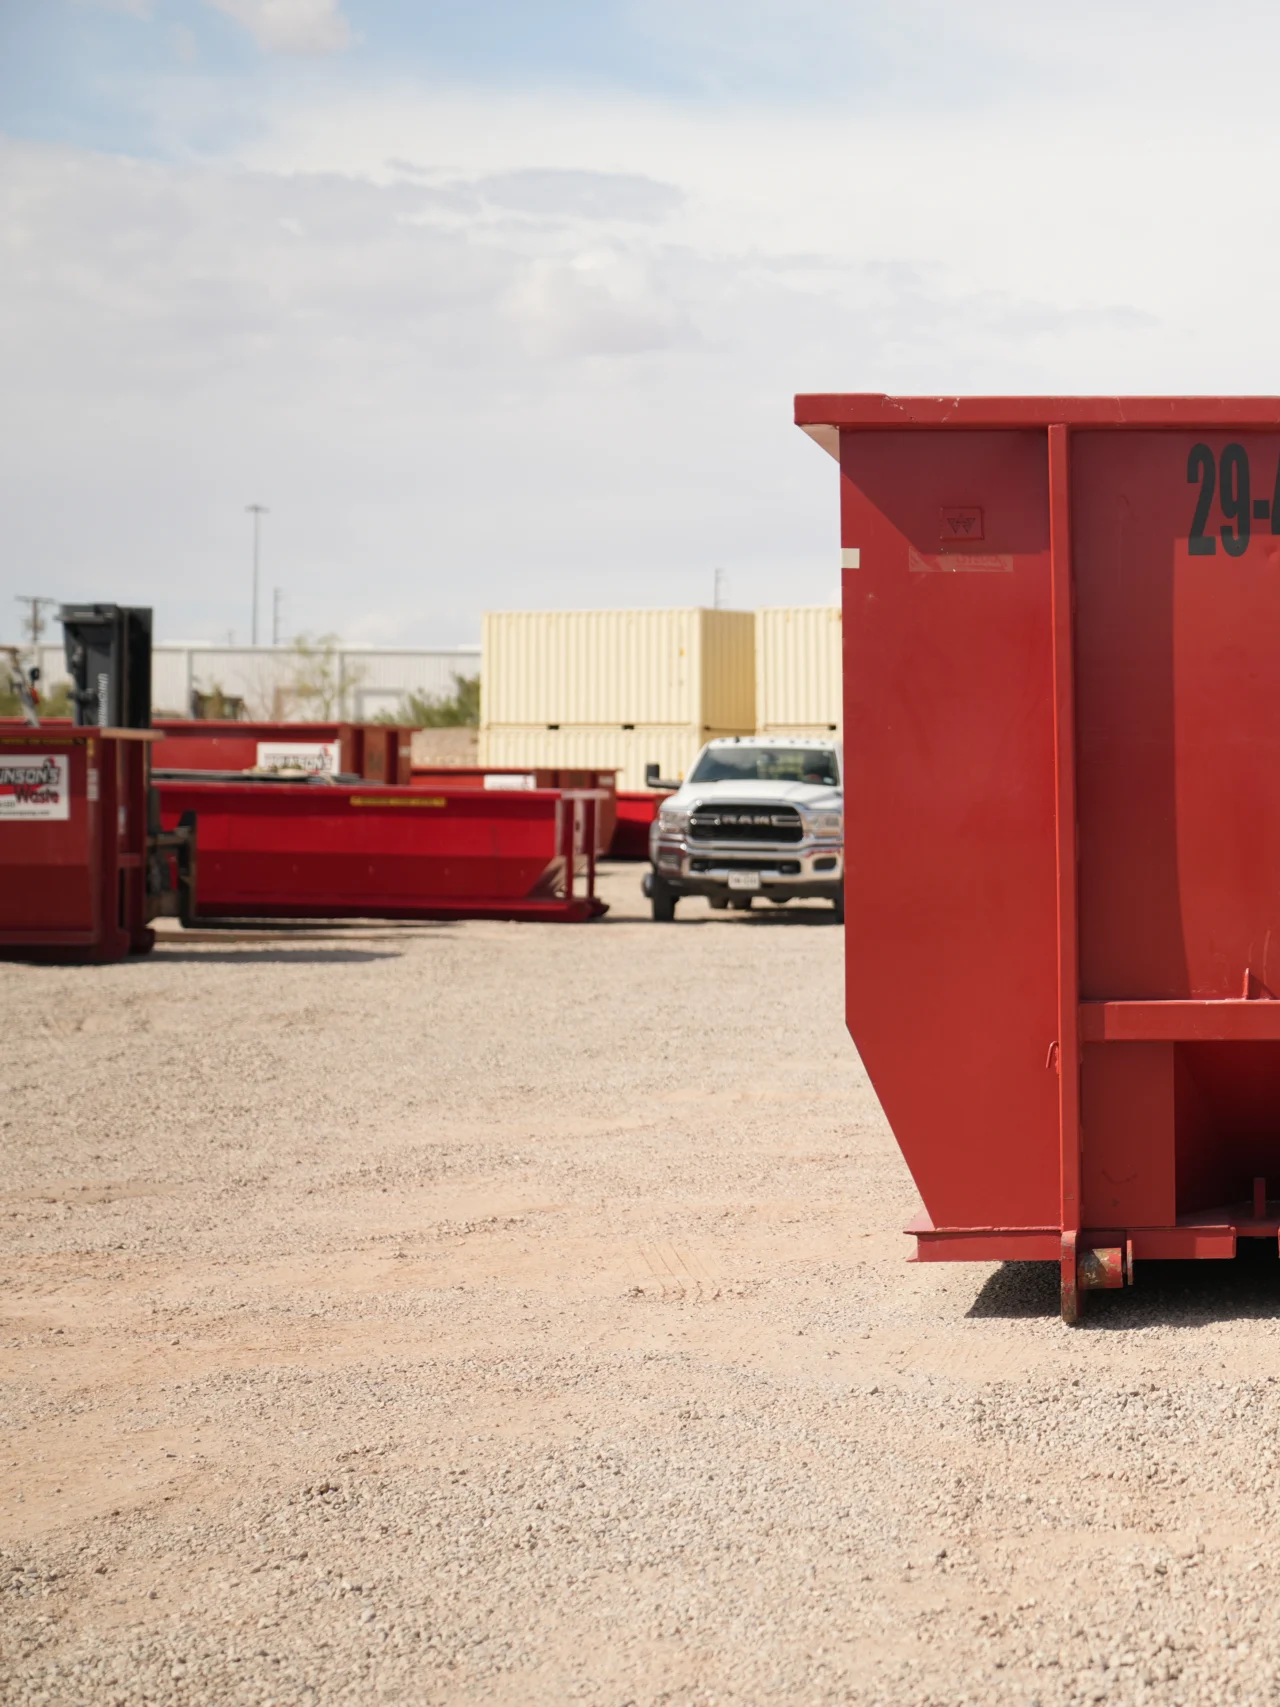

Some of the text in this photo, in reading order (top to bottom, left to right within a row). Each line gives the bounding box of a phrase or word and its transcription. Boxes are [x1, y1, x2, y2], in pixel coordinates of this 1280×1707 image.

[0, 766, 60, 785] NSON'S
[15, 784, 60, 804] Waste
[721, 814, 770, 825] RAM
